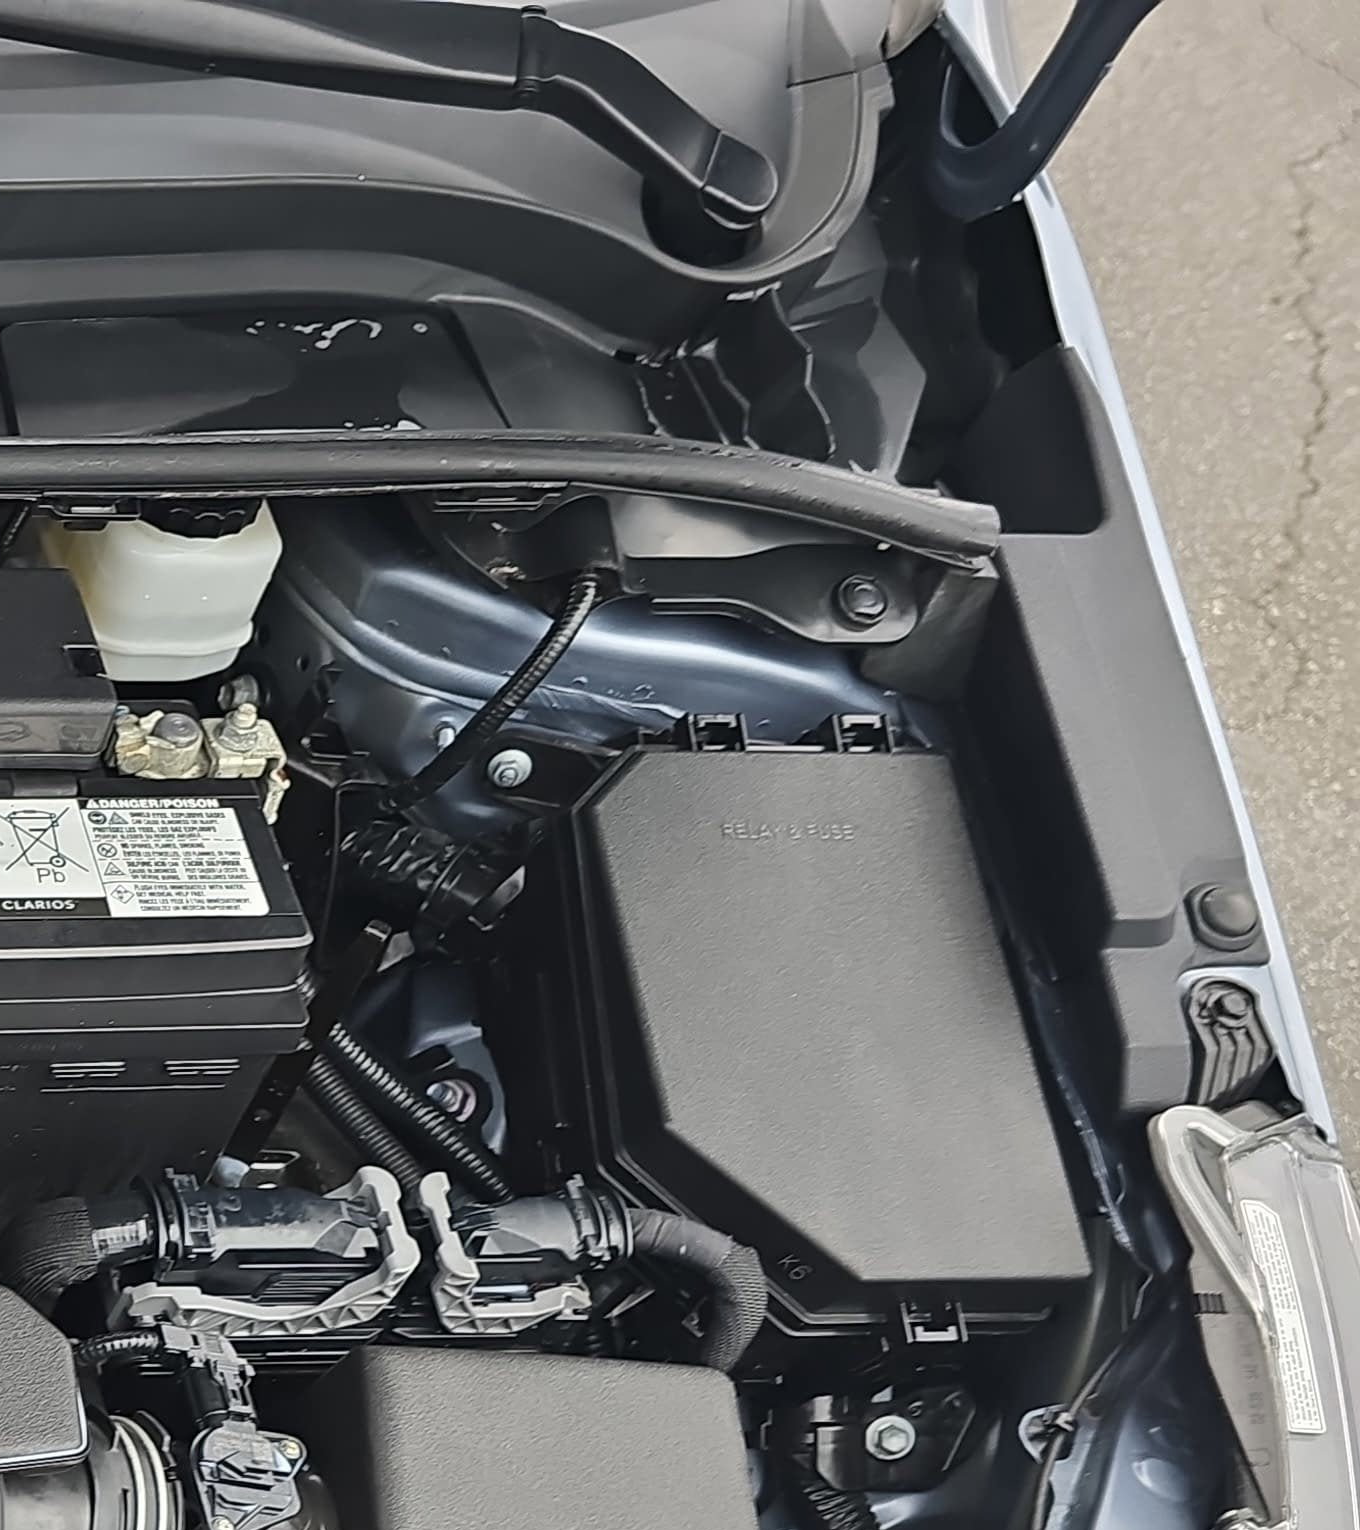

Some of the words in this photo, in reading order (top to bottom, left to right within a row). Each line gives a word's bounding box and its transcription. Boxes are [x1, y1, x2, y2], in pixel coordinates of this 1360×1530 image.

[98, 800, 220, 808] DANGER/POISON
[36, 868, 66, 883] Pb
[1, 900, 76, 911] CLARIOS
[777, 1254, 812, 1280] K6
